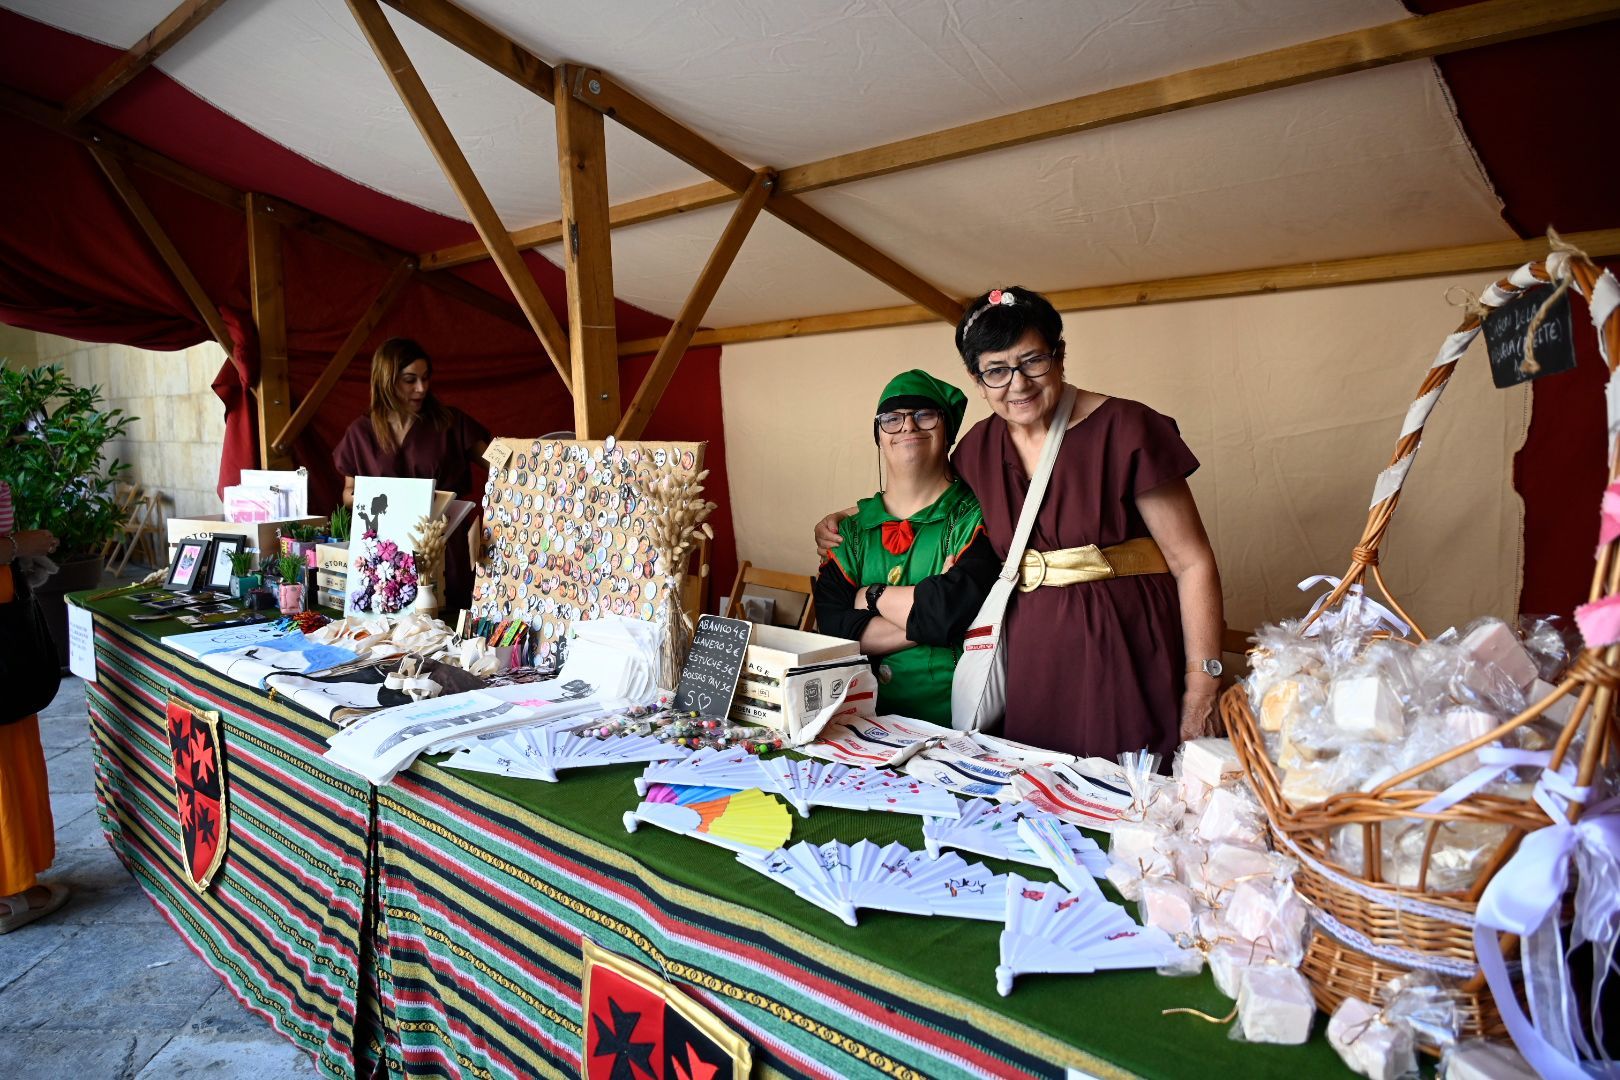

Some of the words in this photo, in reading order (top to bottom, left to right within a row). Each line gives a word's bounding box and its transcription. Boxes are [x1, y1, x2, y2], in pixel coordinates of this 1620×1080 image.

[699, 620, 731, 633] ABANICO
[733, 626, 746, 639] 4€
[693, 636, 724, 650] LLAVERO
[725, 643, 741, 658] 2€
[689, 654, 722, 669] ESTUCHE
[720, 663, 736, 676] 3€
[683, 668, 706, 682] BOLSAS
[720, 681, 732, 693] 3€
[753, 709, 767, 718] BOX
